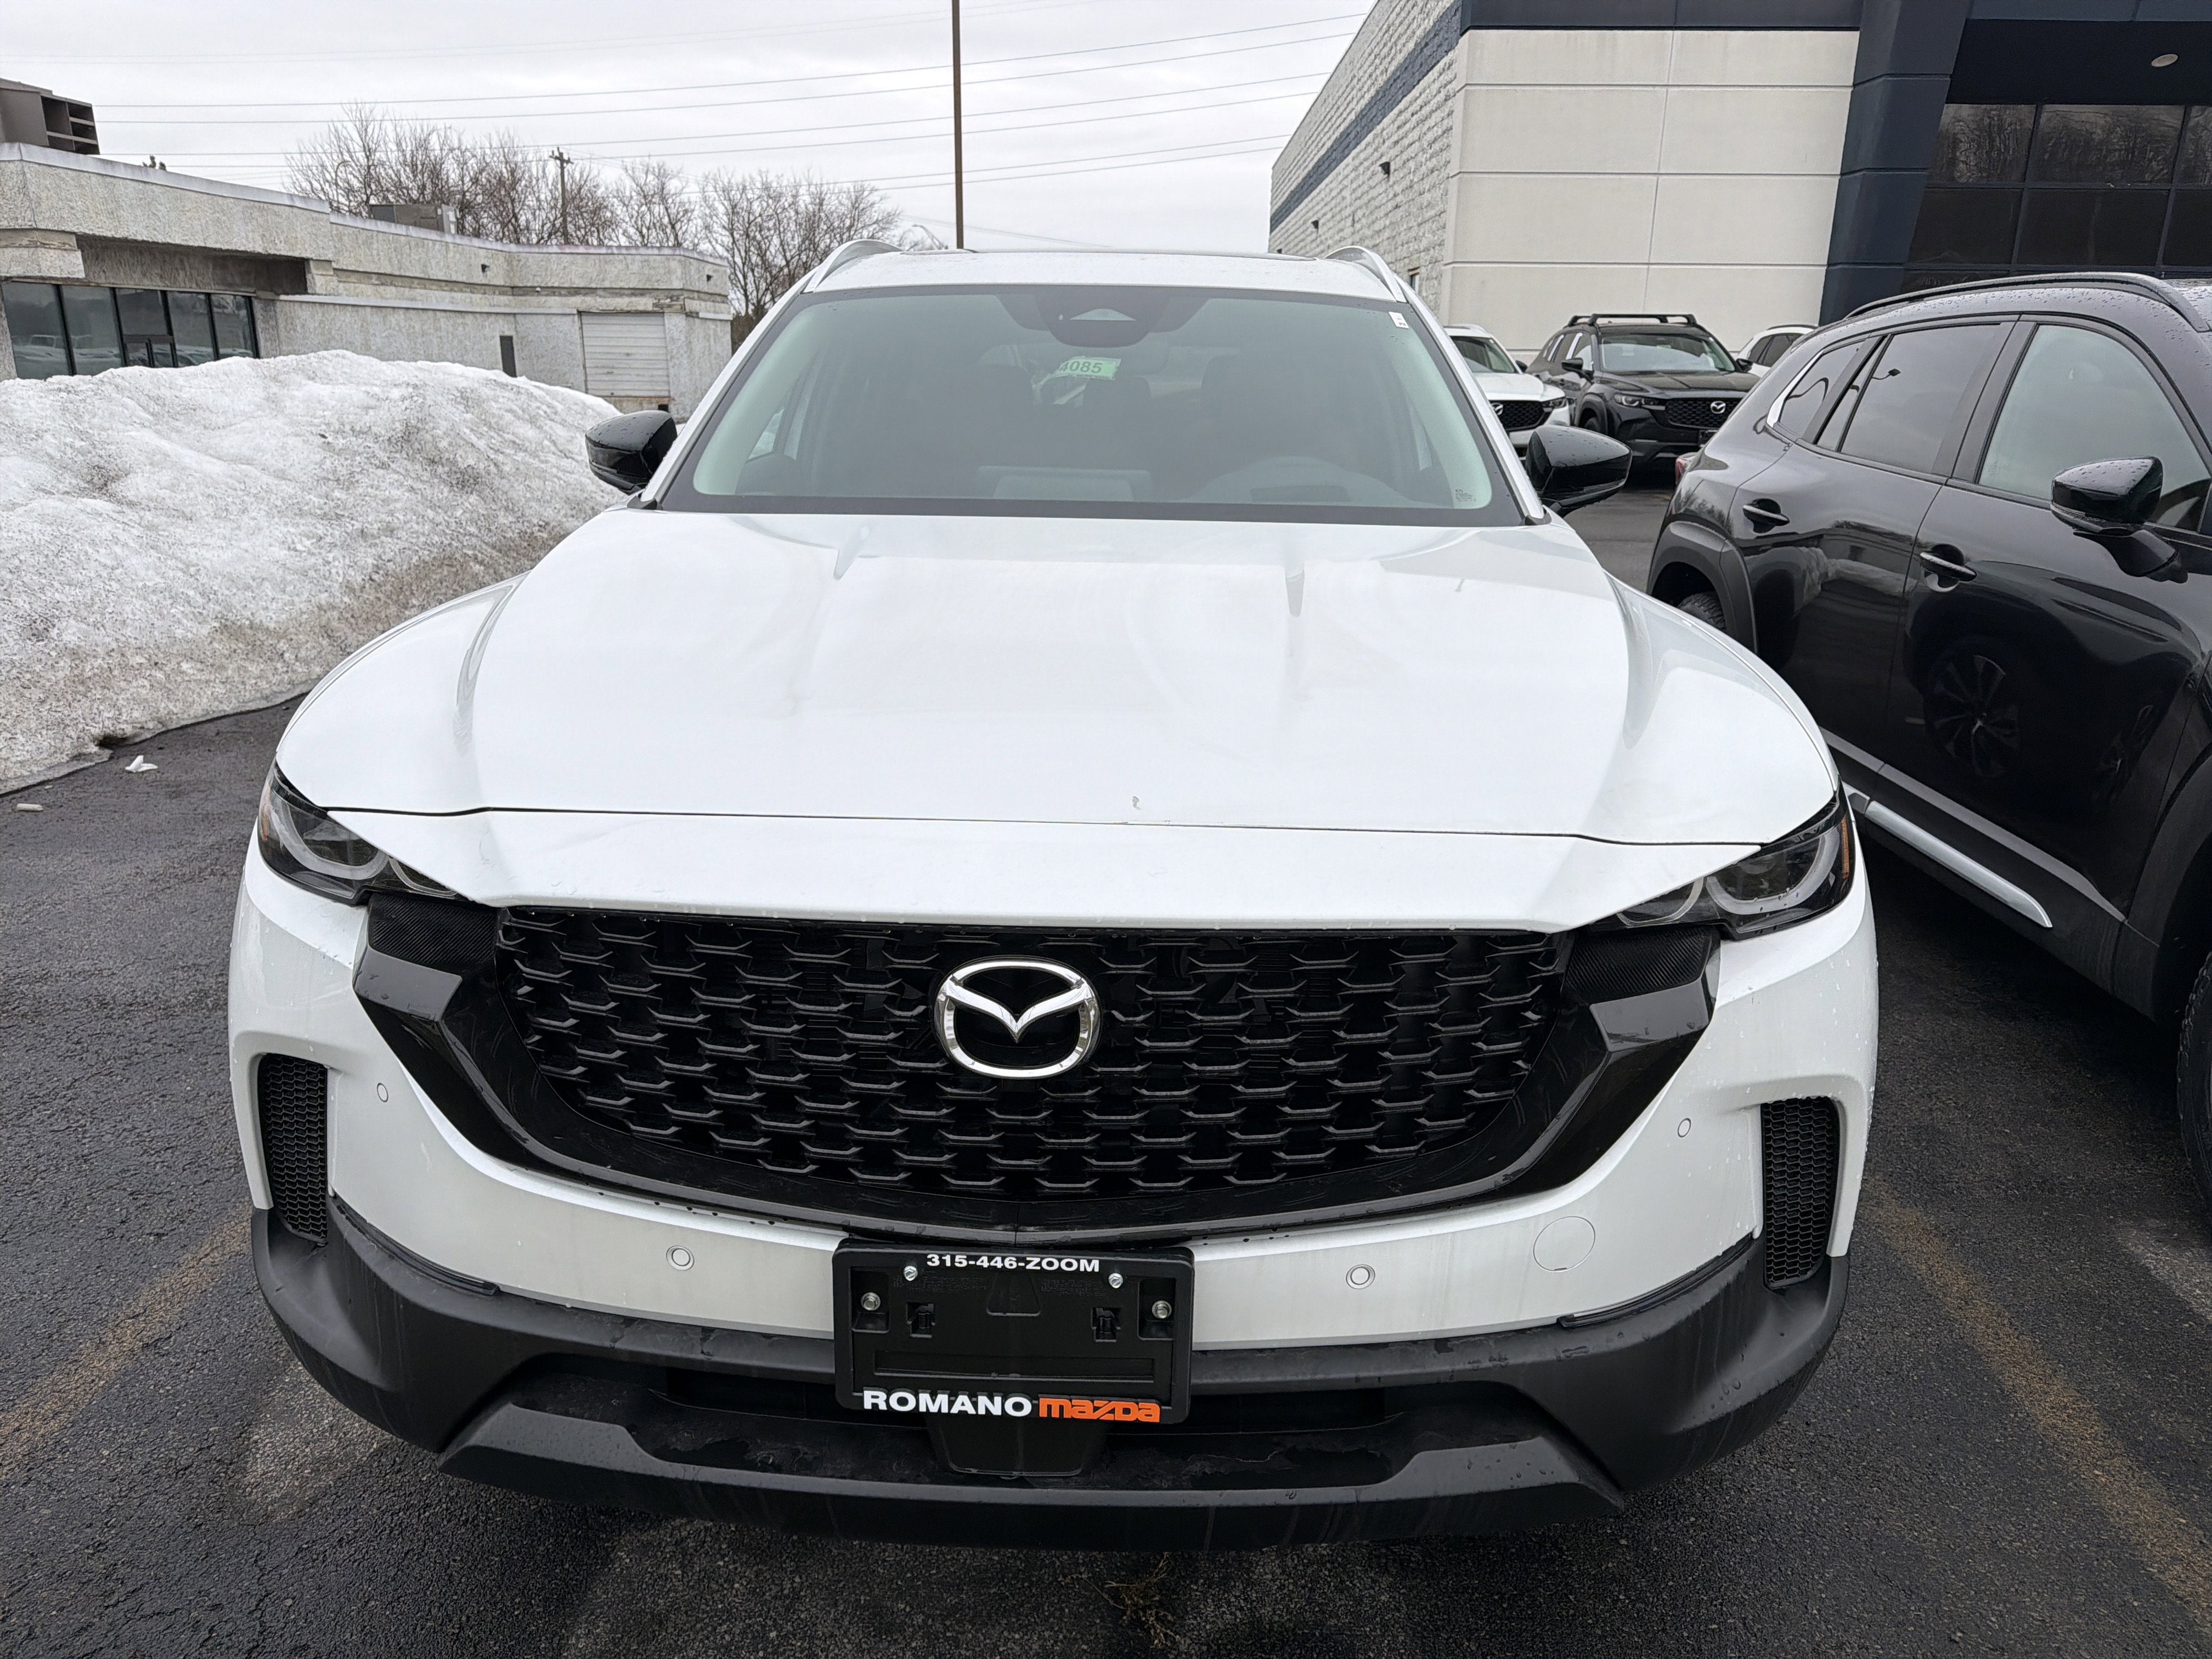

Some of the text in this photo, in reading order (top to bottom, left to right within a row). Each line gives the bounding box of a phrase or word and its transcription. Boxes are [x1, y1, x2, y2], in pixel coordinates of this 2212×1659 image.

[1058, 360, 1103, 374] 4085
[927, 1254, 1099, 1272] 315-446-ZOOM
[863, 1390, 1032, 1417] ROMANO
